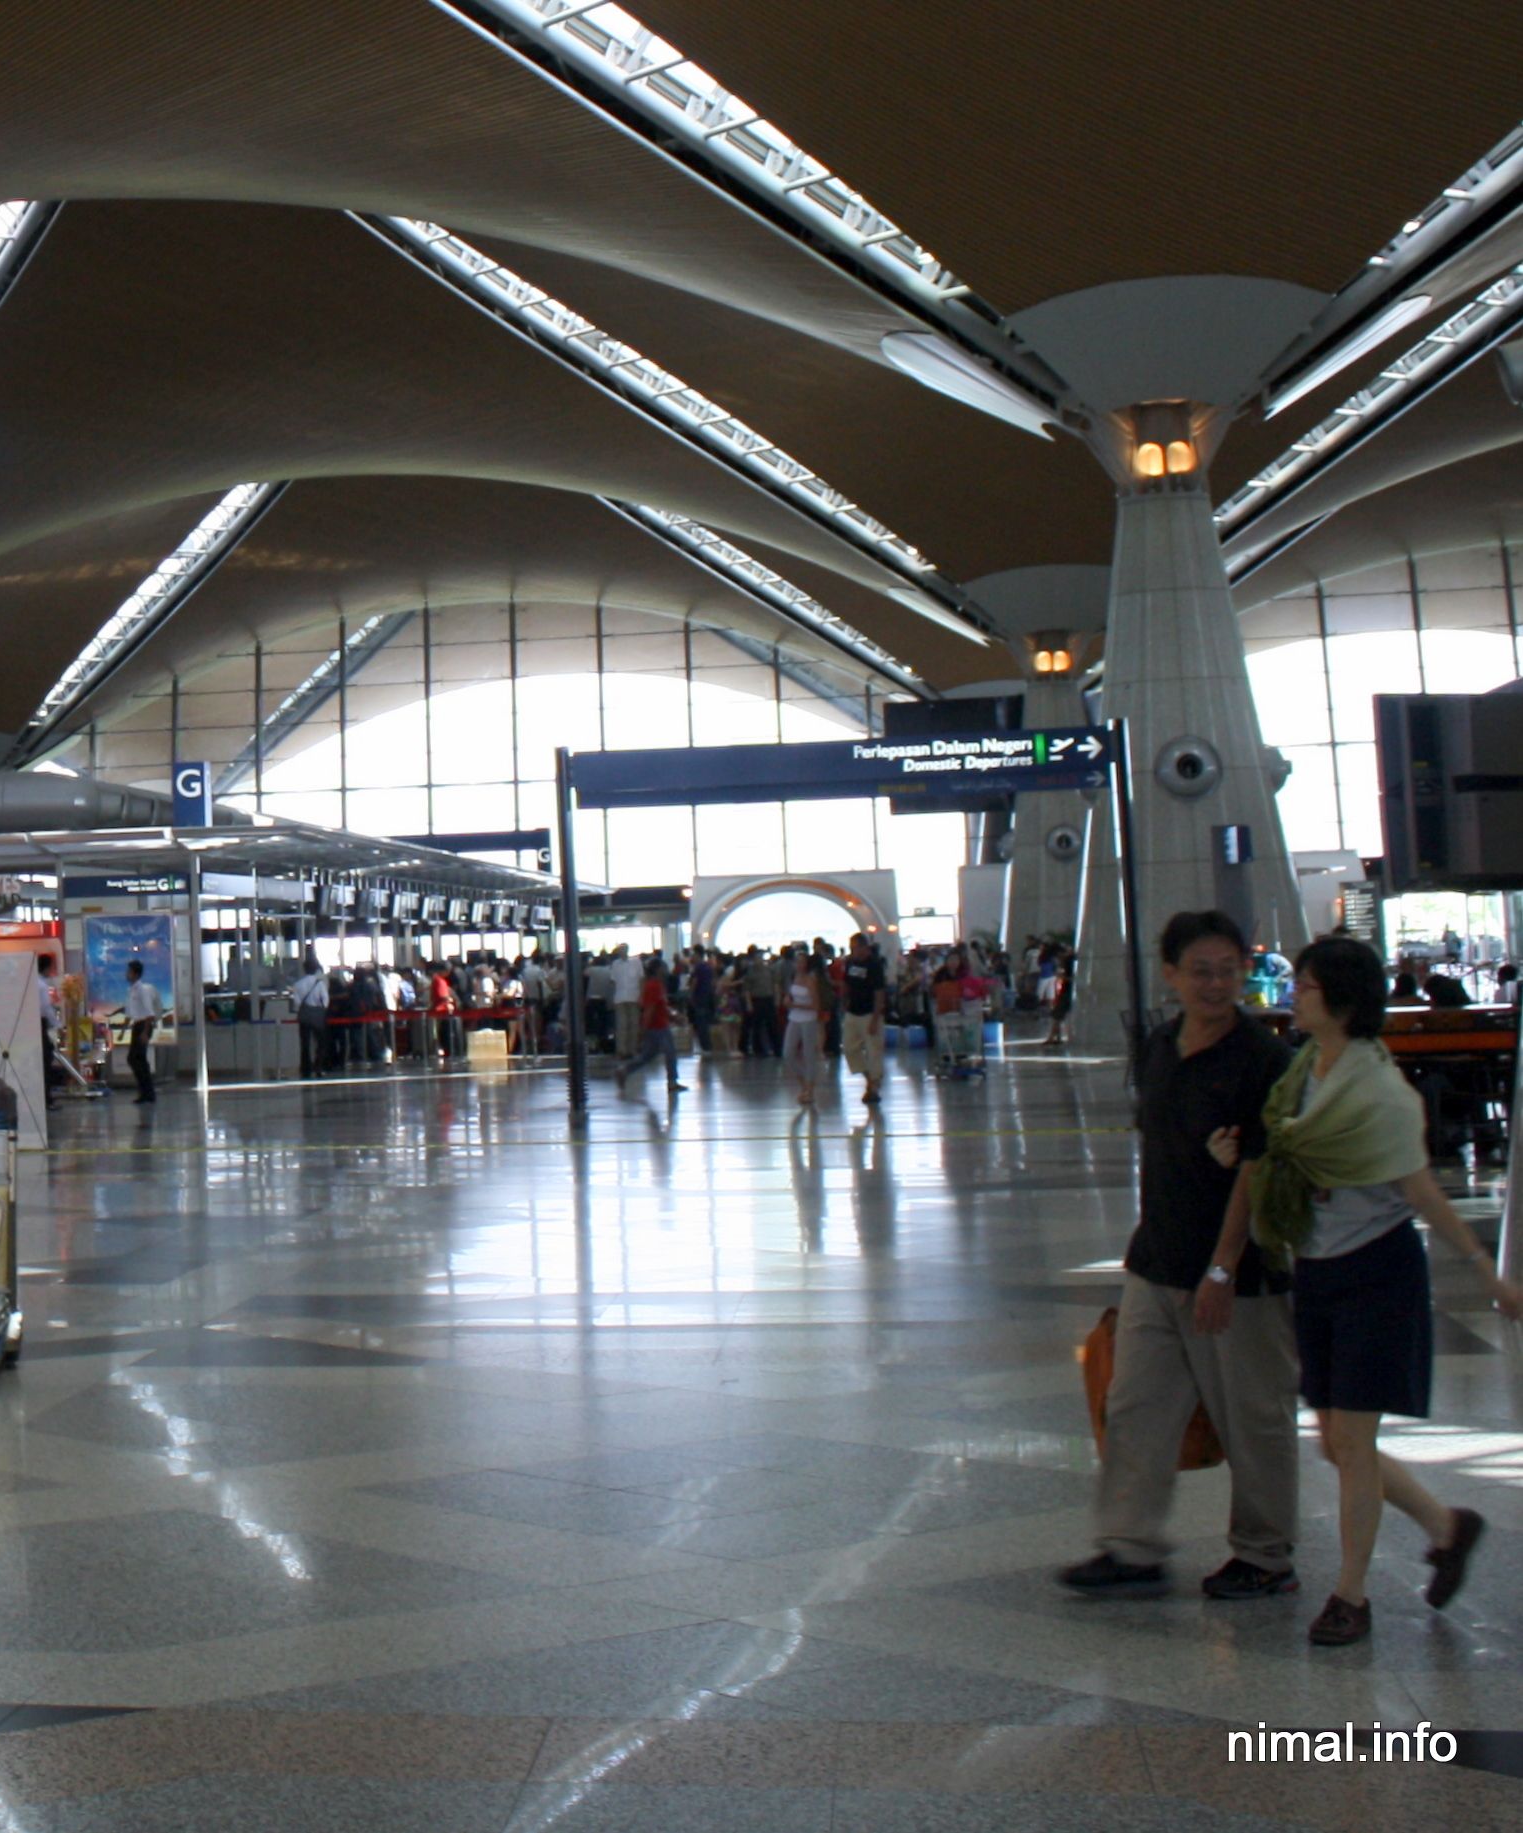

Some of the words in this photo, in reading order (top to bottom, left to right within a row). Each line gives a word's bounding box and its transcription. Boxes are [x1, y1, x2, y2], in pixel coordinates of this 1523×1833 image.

[853, 744, 931, 761] Perlepasan
[932, 739, 980, 756] Dalam
[982, 737, 1034, 756] Negeri
[903, 757, 962, 773] Domestic
[965, 754, 1034, 772] Departures
[176, 768, 203, 798] G
[538, 847, 552, 863] G
